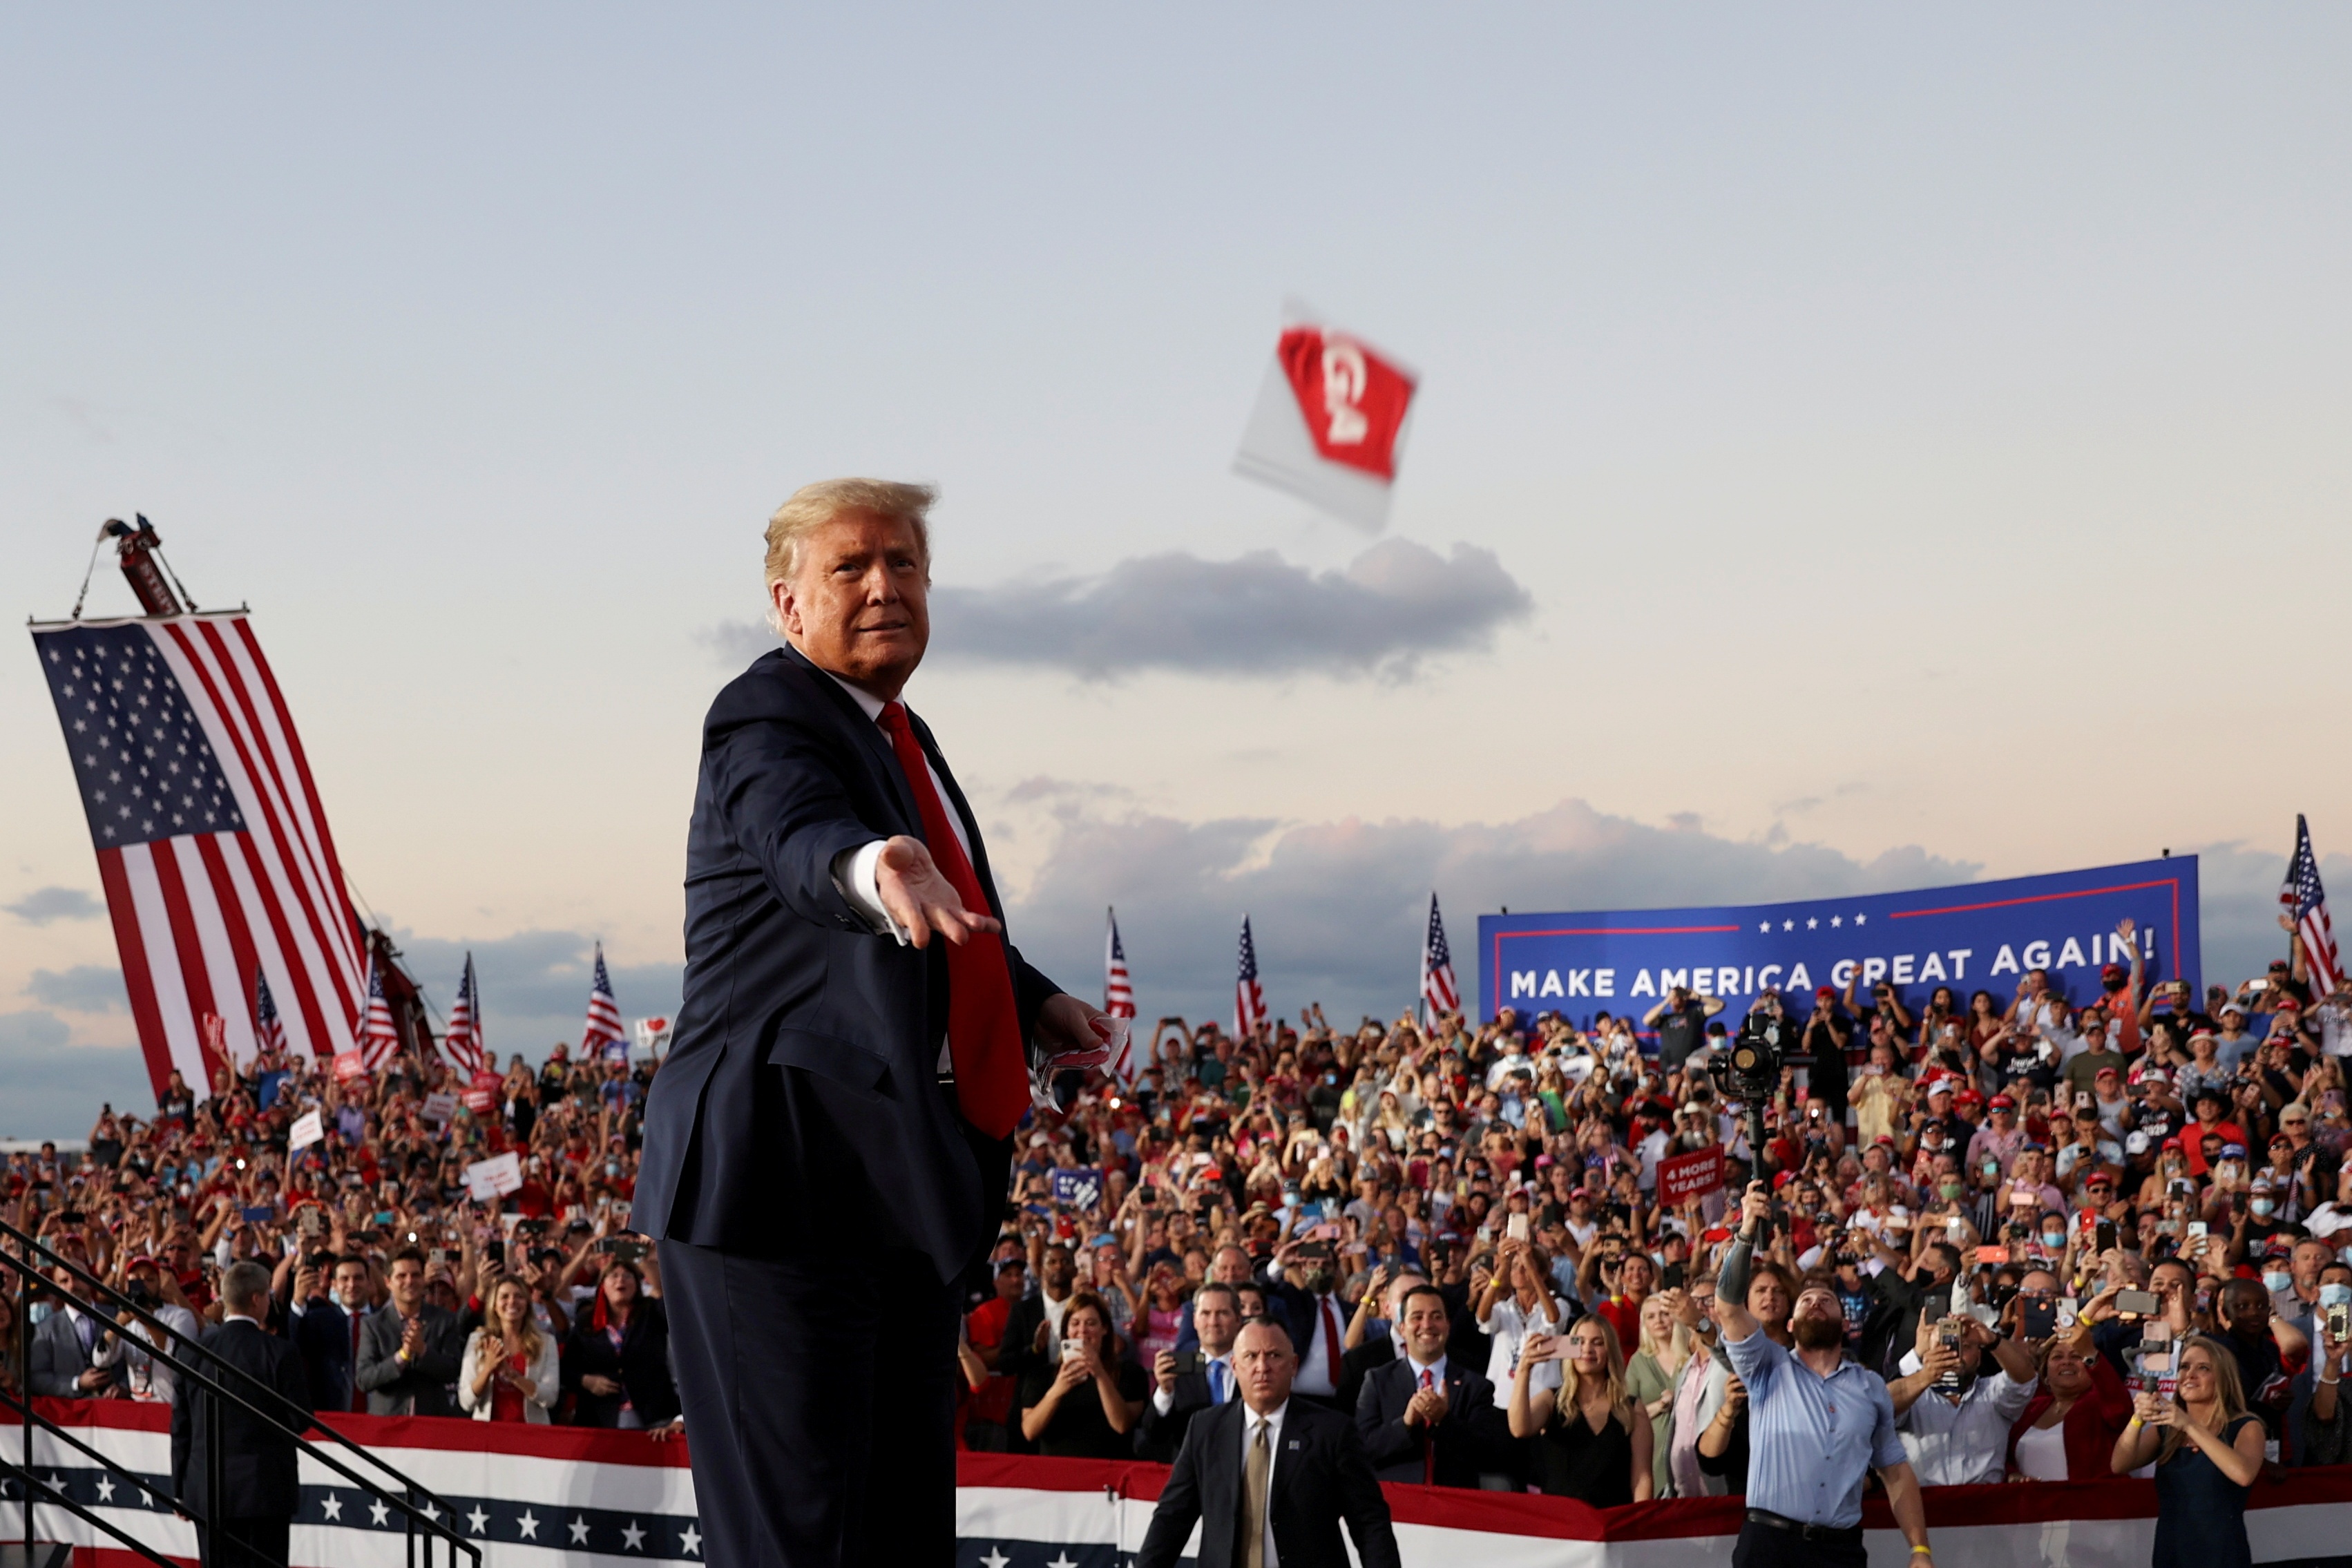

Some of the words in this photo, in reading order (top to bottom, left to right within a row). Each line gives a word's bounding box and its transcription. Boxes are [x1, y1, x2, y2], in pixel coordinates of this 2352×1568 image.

[1511, 968, 1616, 999] MAKE
[1629, 962, 1813, 997] AMERICA
[1830, 948, 1973, 989] GREAT
[1990, 927, 2154, 977] AGAIN!
[1666, 1168, 1677, 1181] 4
[1679, 1156, 1717, 1179] MORE
[1668, 1171, 1716, 1194] YEARS!
